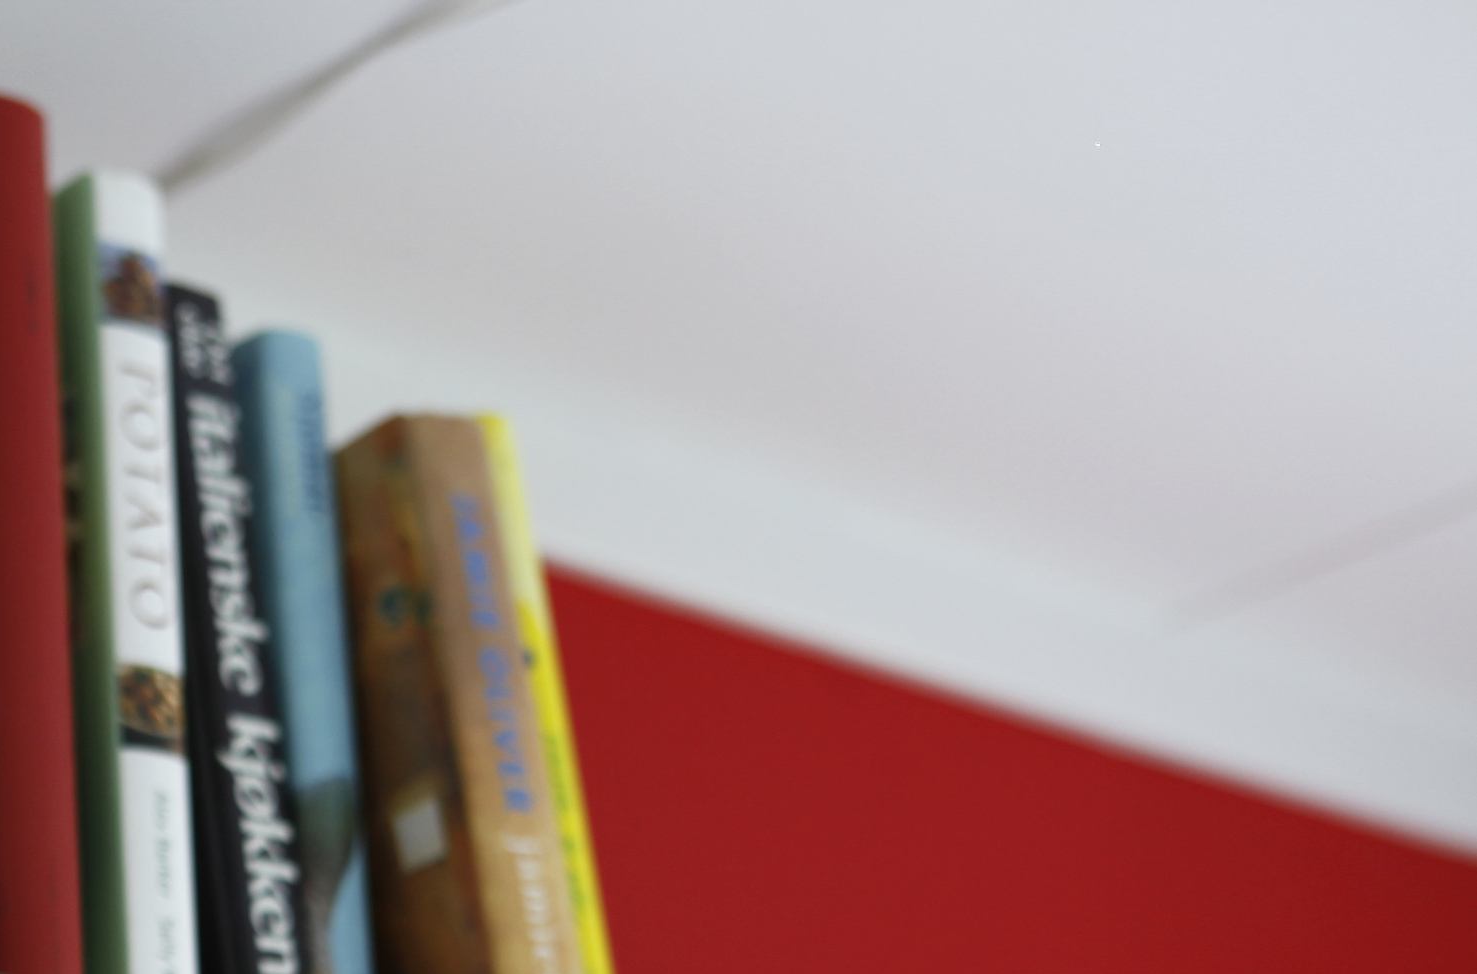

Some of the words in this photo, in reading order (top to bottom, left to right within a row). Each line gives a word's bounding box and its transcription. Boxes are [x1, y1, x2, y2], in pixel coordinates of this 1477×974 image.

[116, 360, 169, 631] POTATO
[186, 392, 270, 697] italienske
[446, 490, 505, 632] JAMIE
[476, 646, 535, 815] OLIVER
